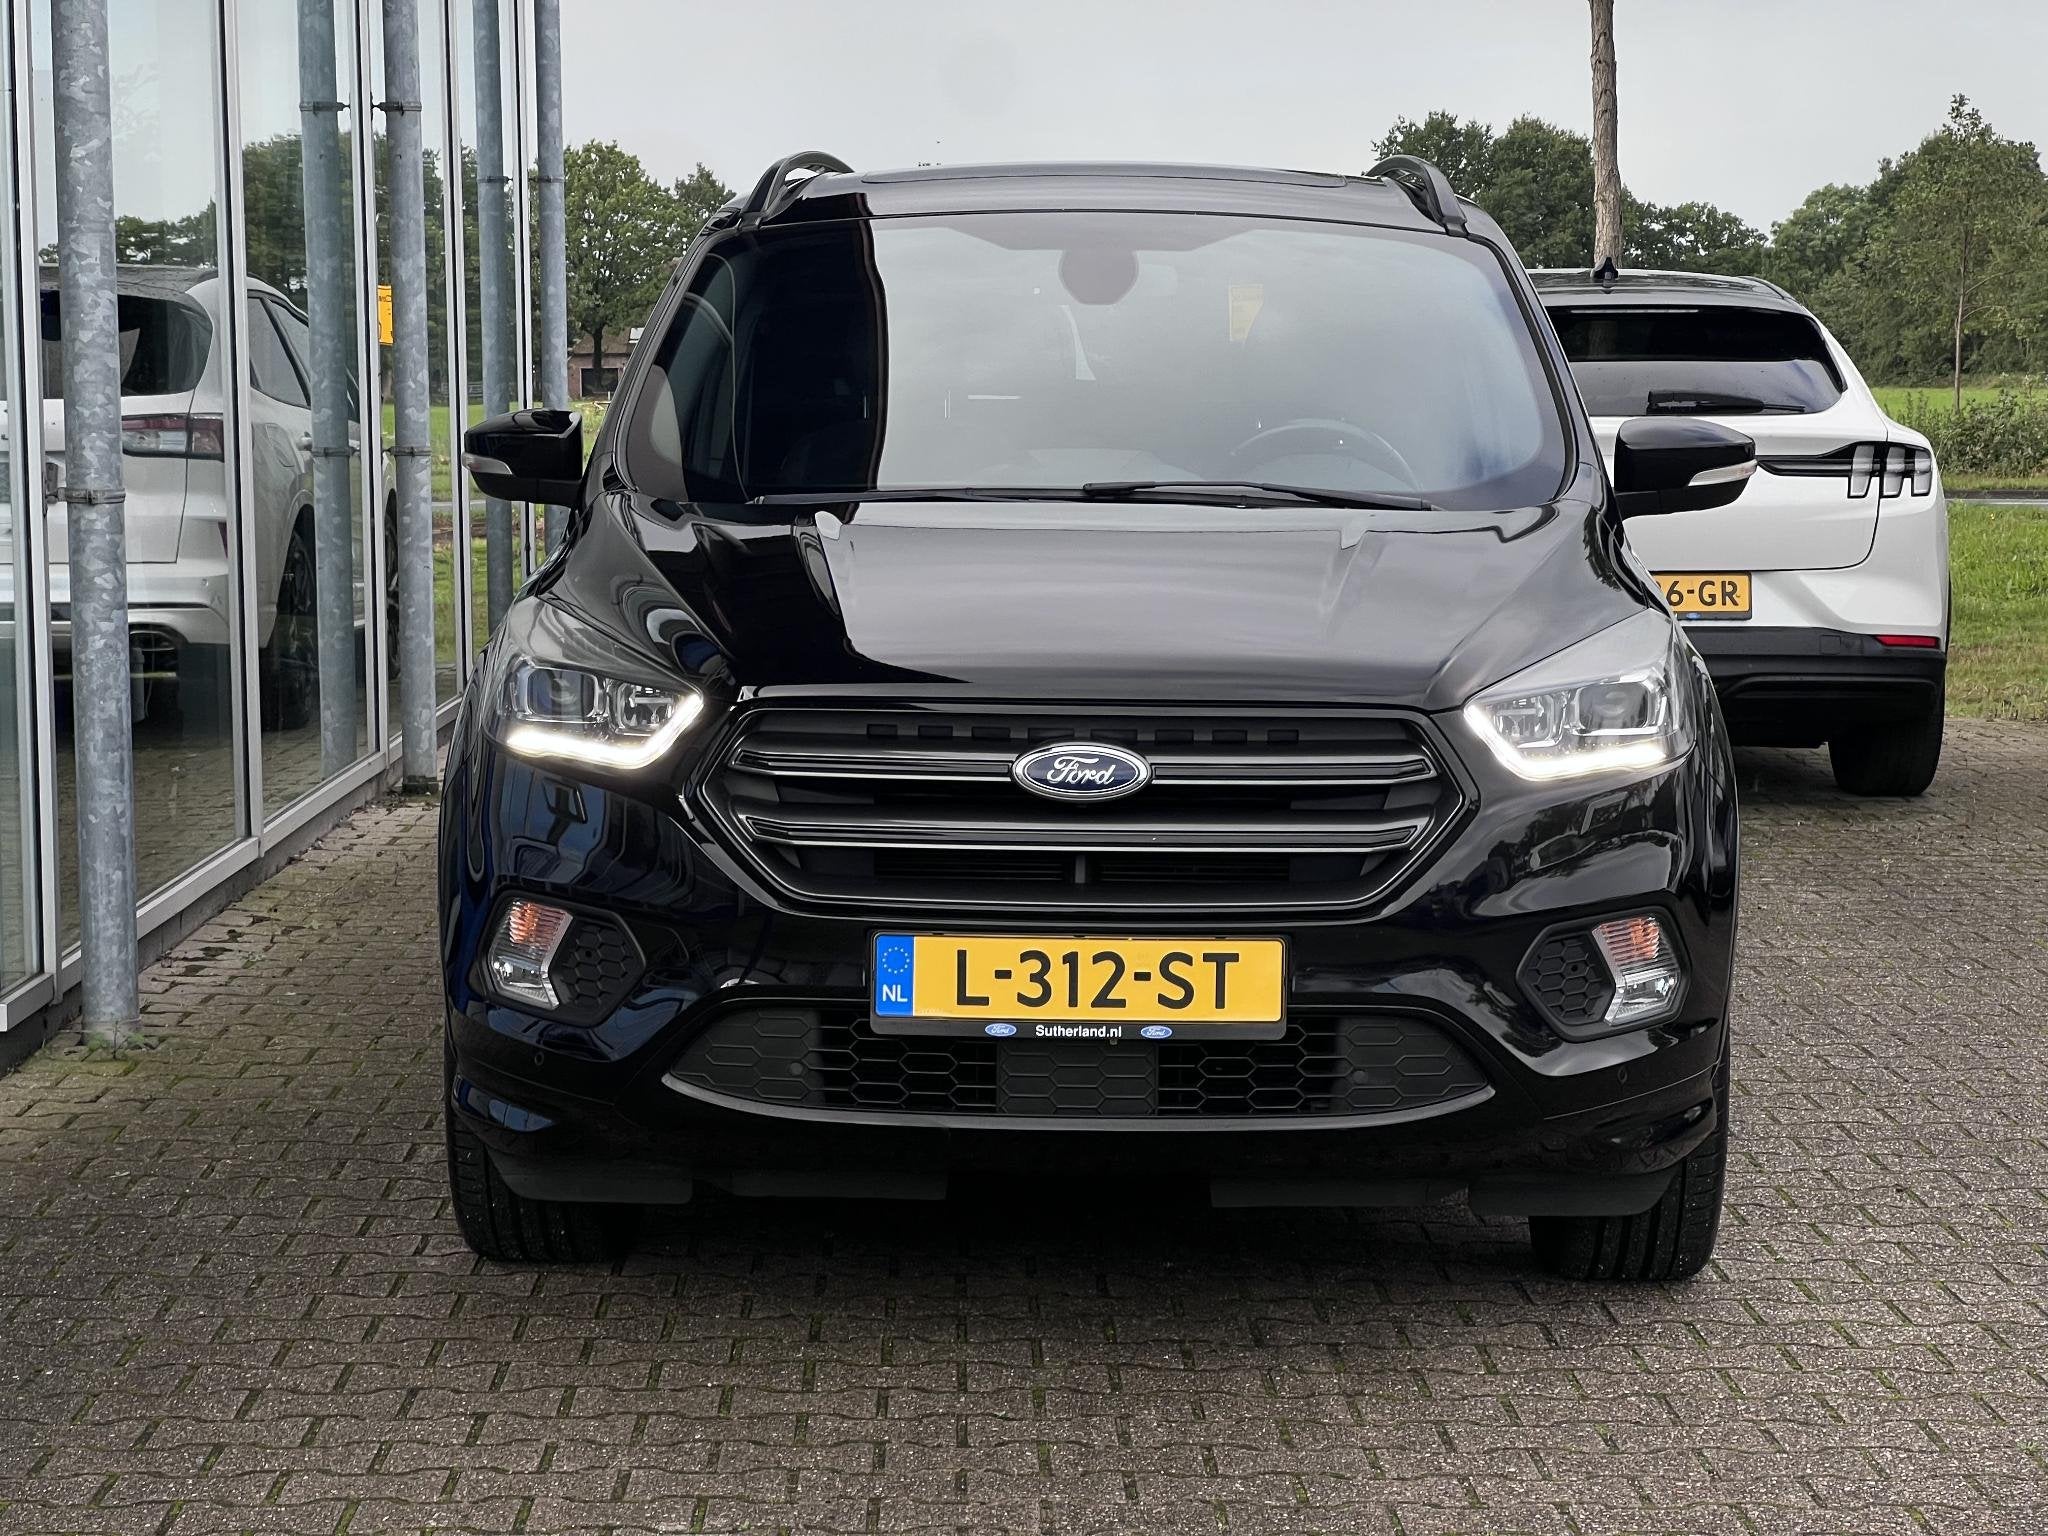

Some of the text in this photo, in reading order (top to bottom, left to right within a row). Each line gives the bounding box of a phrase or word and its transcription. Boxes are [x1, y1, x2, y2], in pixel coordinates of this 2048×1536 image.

[1656, 579, 1739, 607] 6-GR
[1046, 755, 1117, 785] Ford
[882, 984, 908, 1002] NL
[956, 949, 1240, 1009] L-312-ST
[1035, 1024, 1122, 1038] Sutherland.nl
